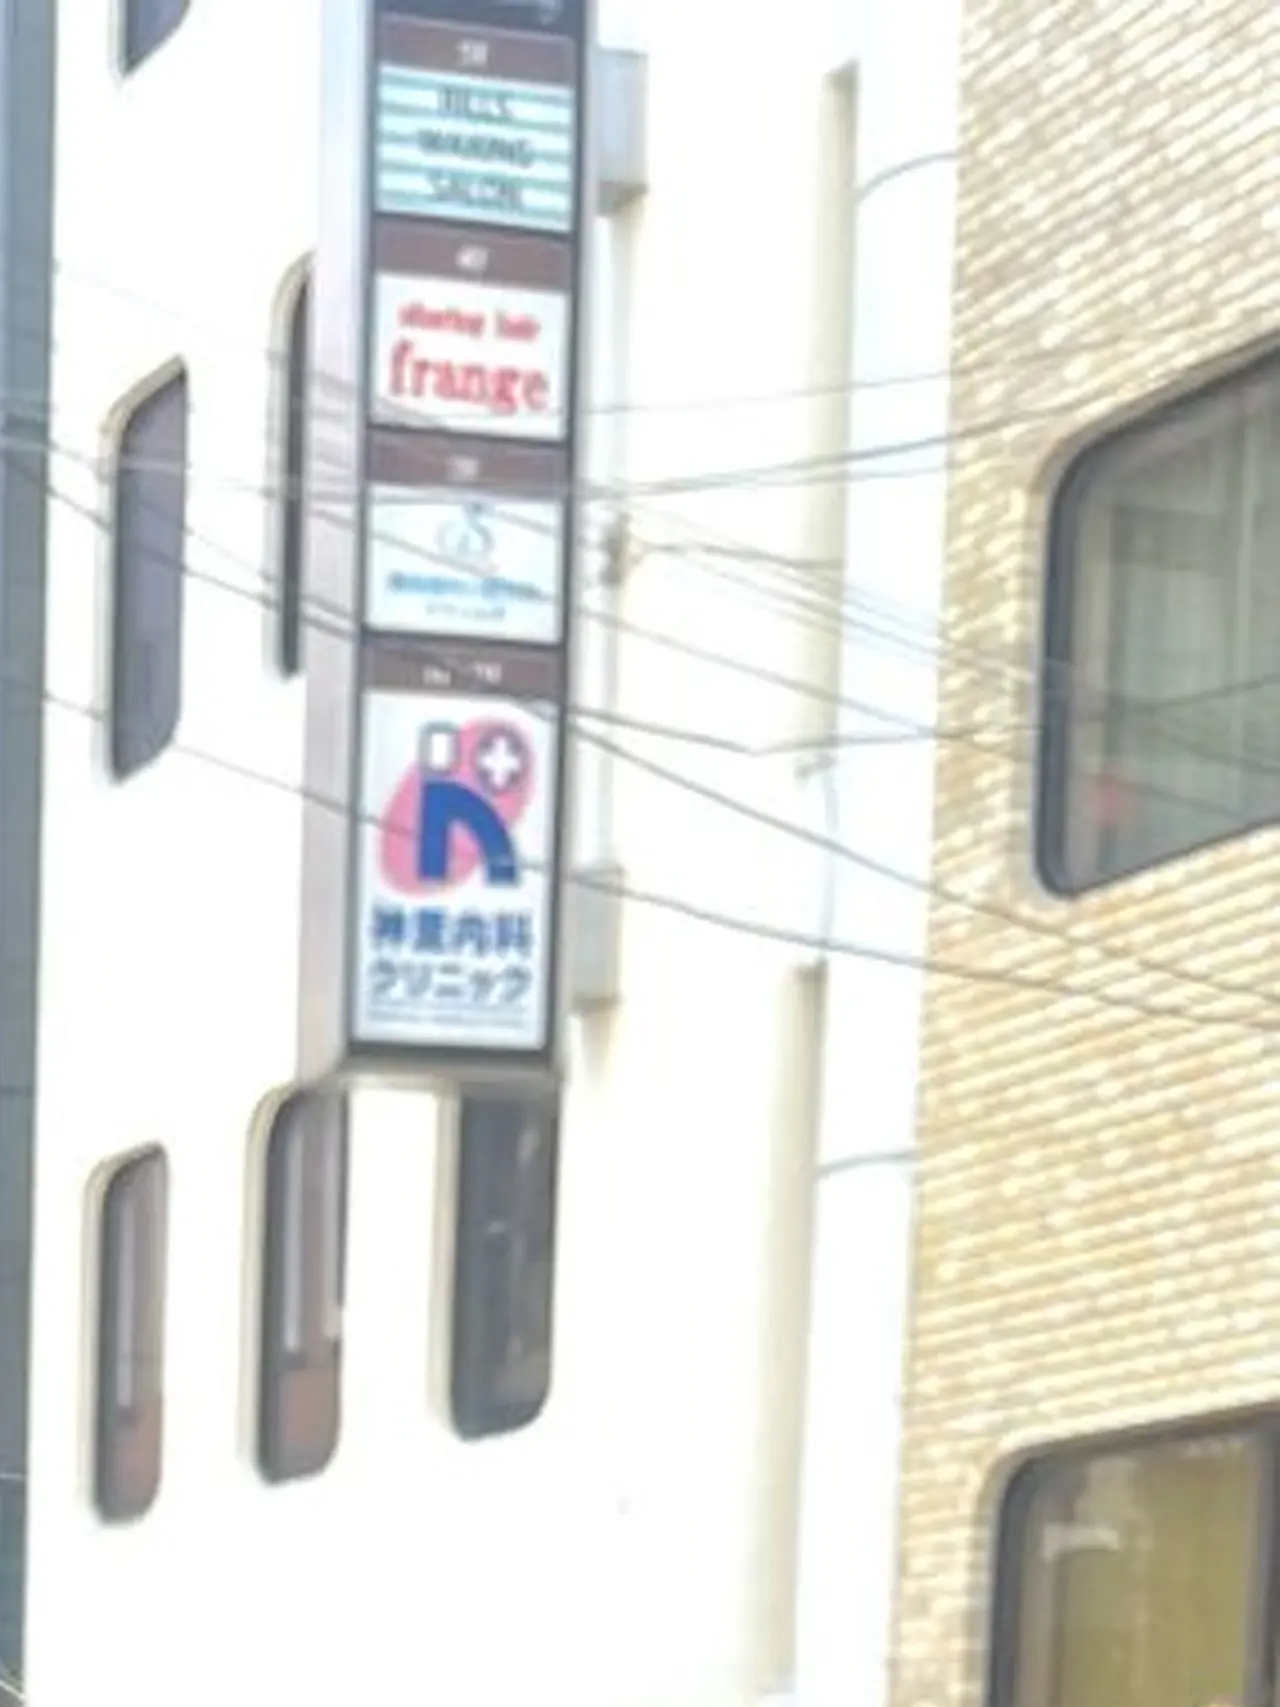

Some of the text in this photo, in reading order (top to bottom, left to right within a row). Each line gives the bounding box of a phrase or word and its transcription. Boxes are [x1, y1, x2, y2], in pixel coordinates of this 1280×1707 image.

[391, 338, 549, 416] frange
[367, 958, 533, 1003] クリニック
